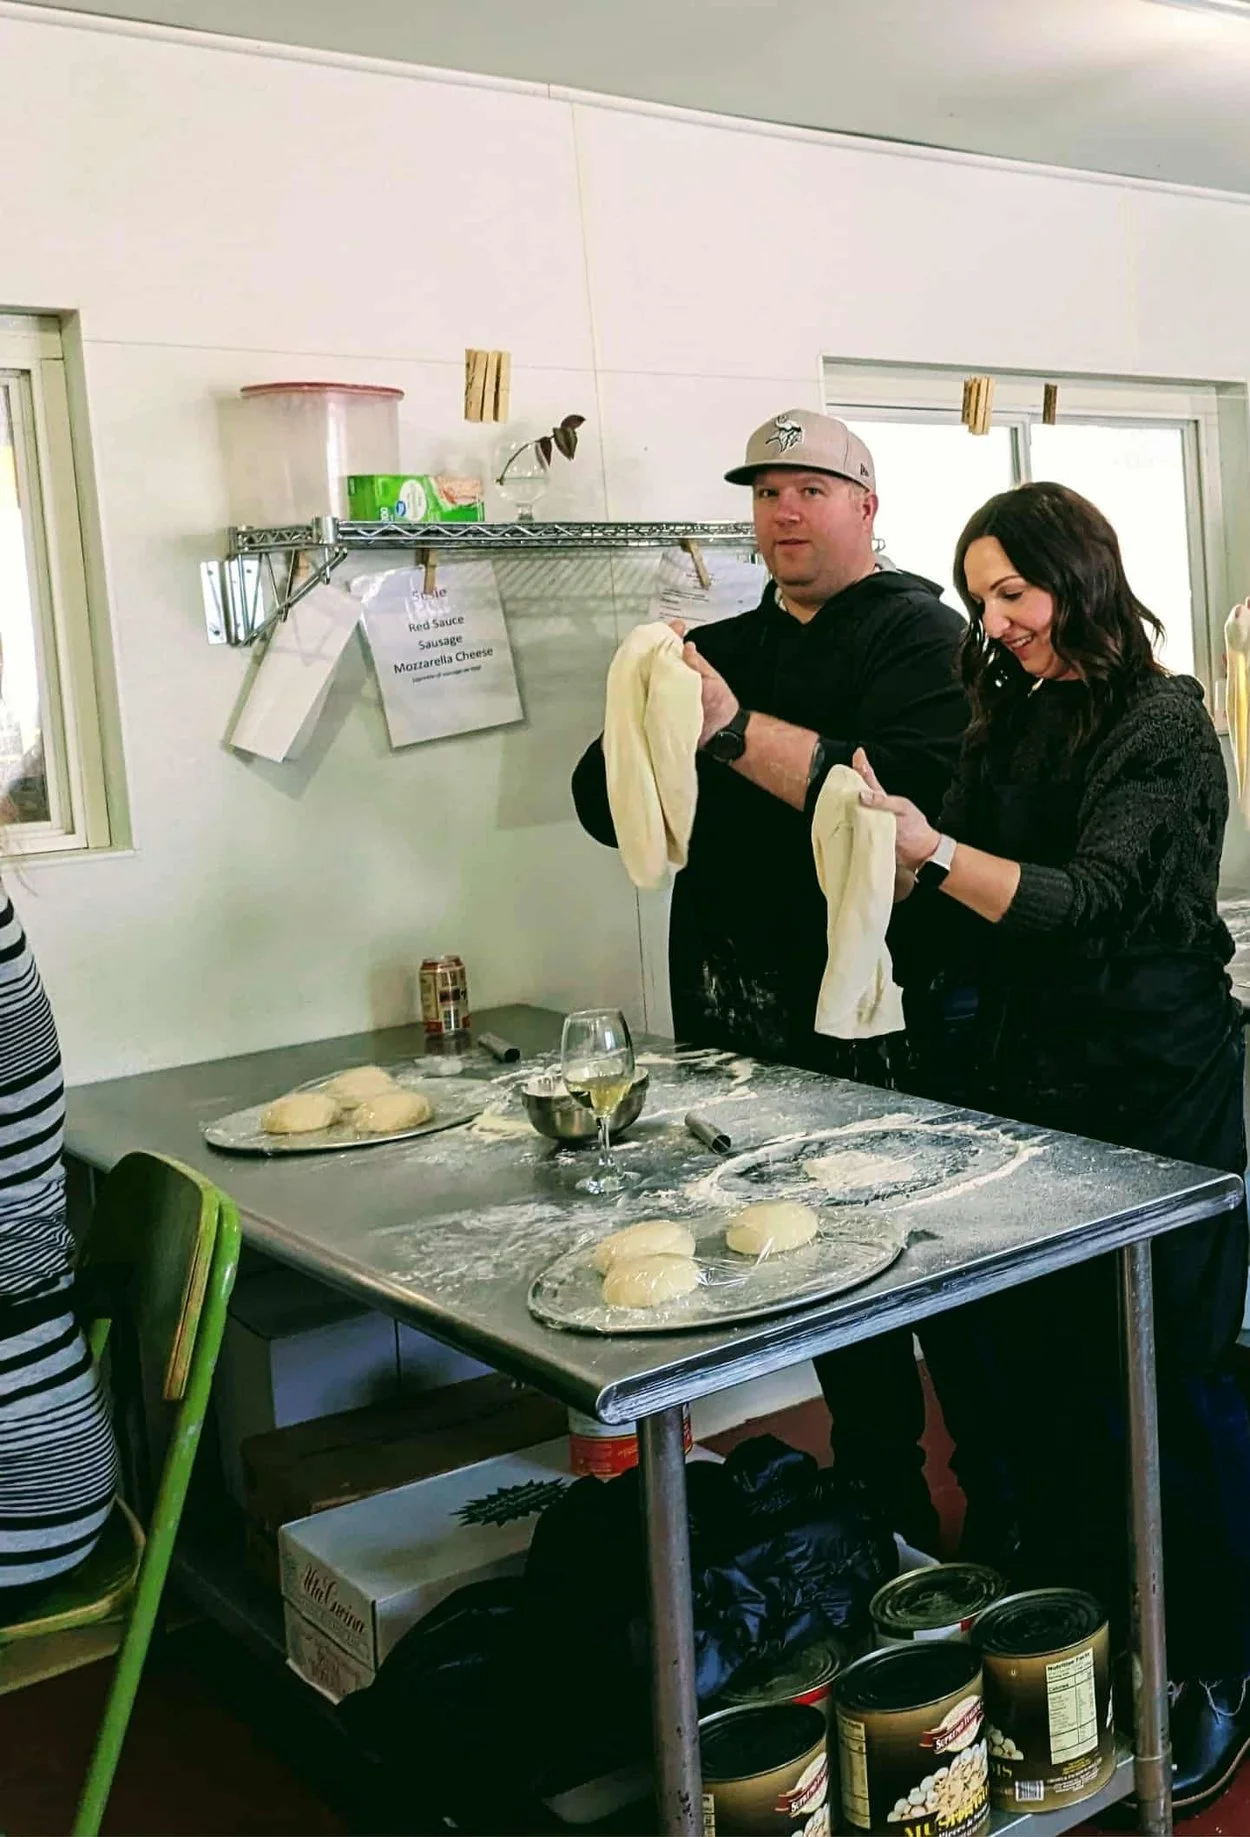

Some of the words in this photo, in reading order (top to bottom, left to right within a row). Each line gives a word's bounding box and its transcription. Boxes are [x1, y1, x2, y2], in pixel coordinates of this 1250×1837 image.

[408, 621, 431, 633] Red
[432, 615, 465, 629] Sauce
[418, 634, 463, 650] Sausage
[393, 653, 453, 674] Mozzarella
[455, 647, 494, 662] Cheese
